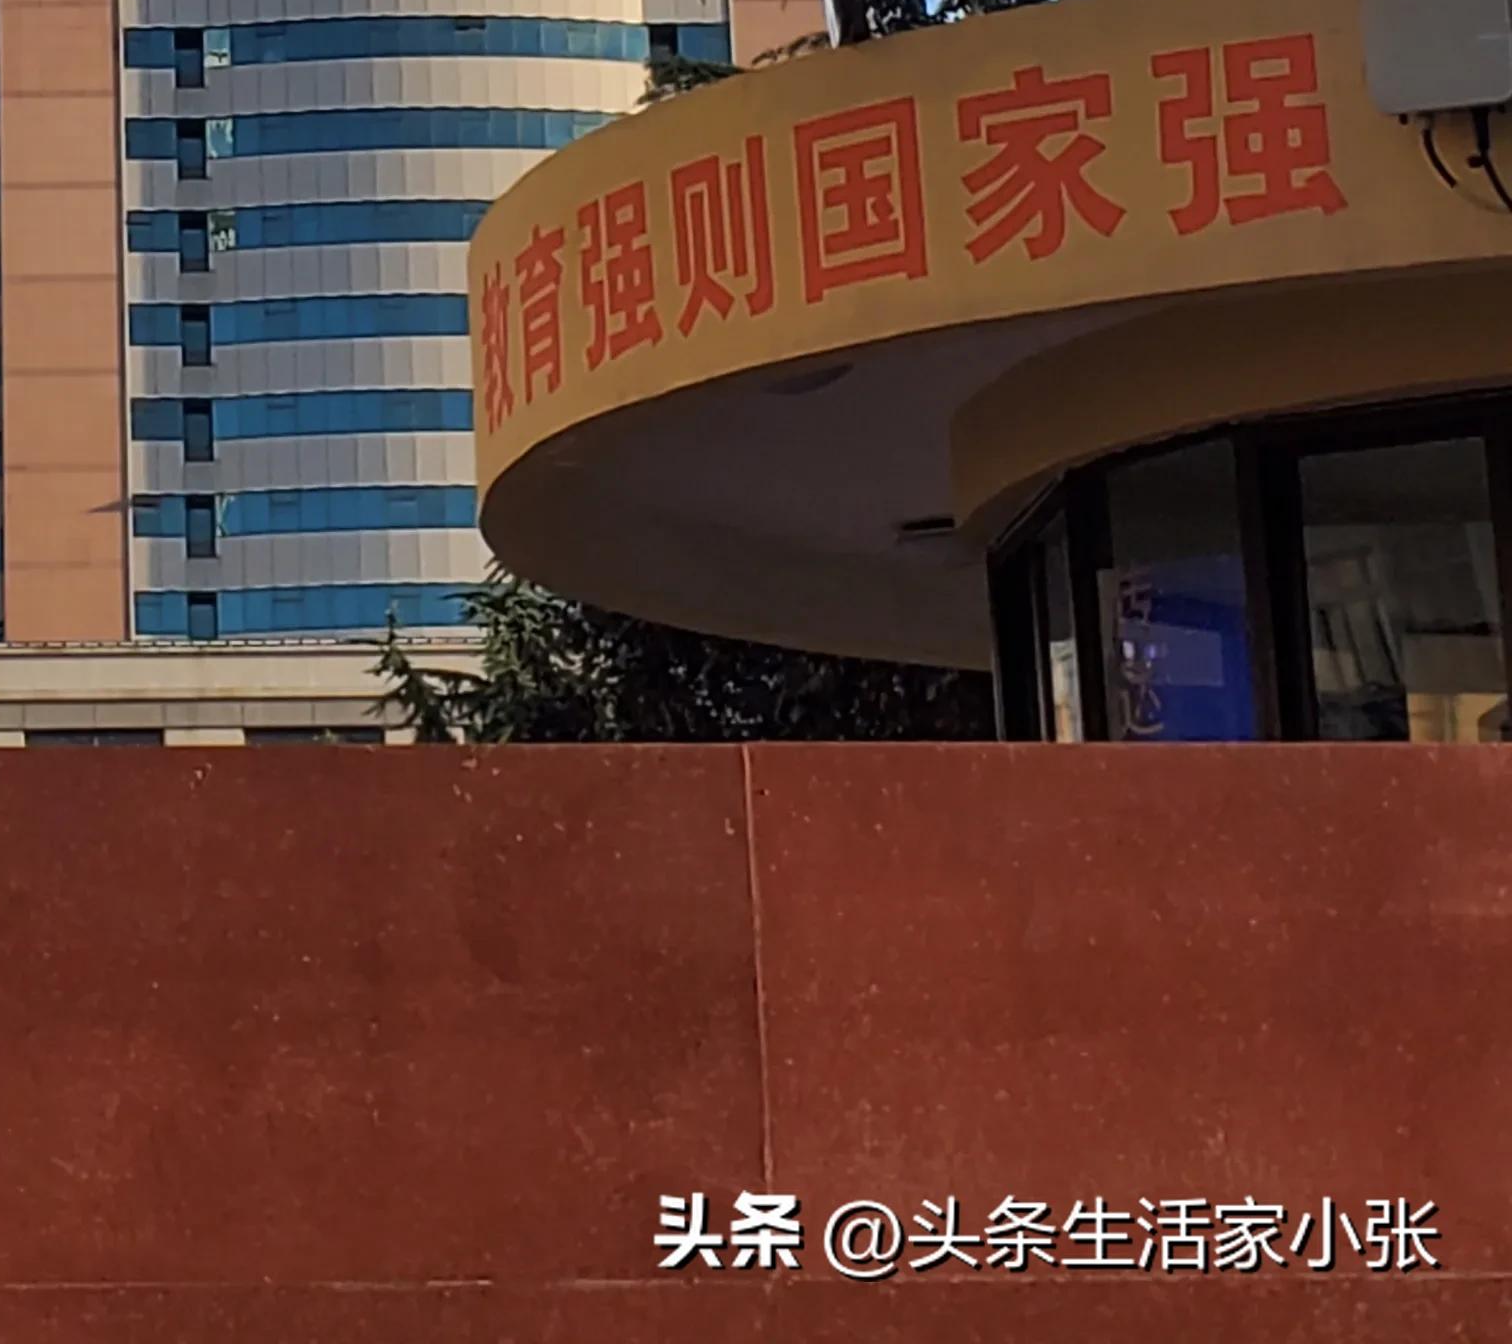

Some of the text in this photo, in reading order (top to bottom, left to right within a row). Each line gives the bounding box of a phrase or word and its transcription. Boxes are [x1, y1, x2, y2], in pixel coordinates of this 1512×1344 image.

[482, 34, 1345, 434] 教育强则国家强
